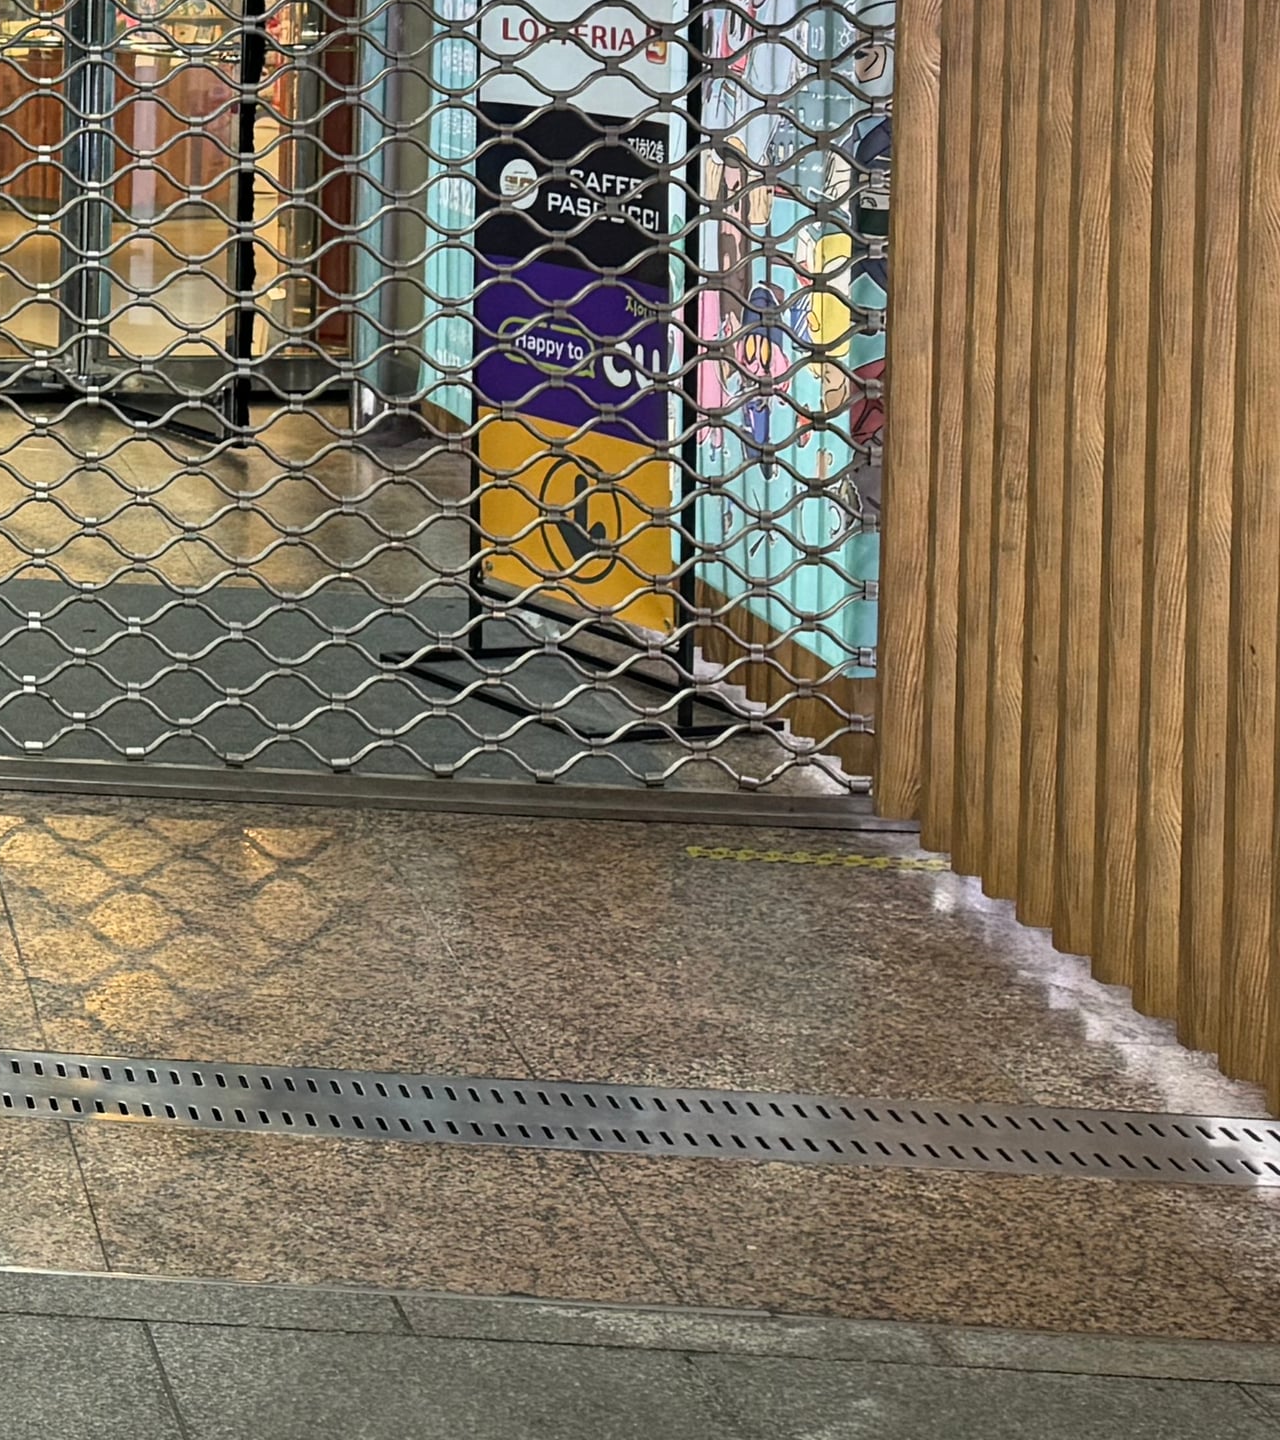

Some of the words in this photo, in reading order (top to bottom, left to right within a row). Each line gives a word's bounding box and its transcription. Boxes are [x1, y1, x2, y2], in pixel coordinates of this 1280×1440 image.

[501, 16, 637, 51] LOERIA
[569, 168, 643, 200] CAFFE
[514, 328, 565, 360] Happy
[567, 344, 584, 360] to
